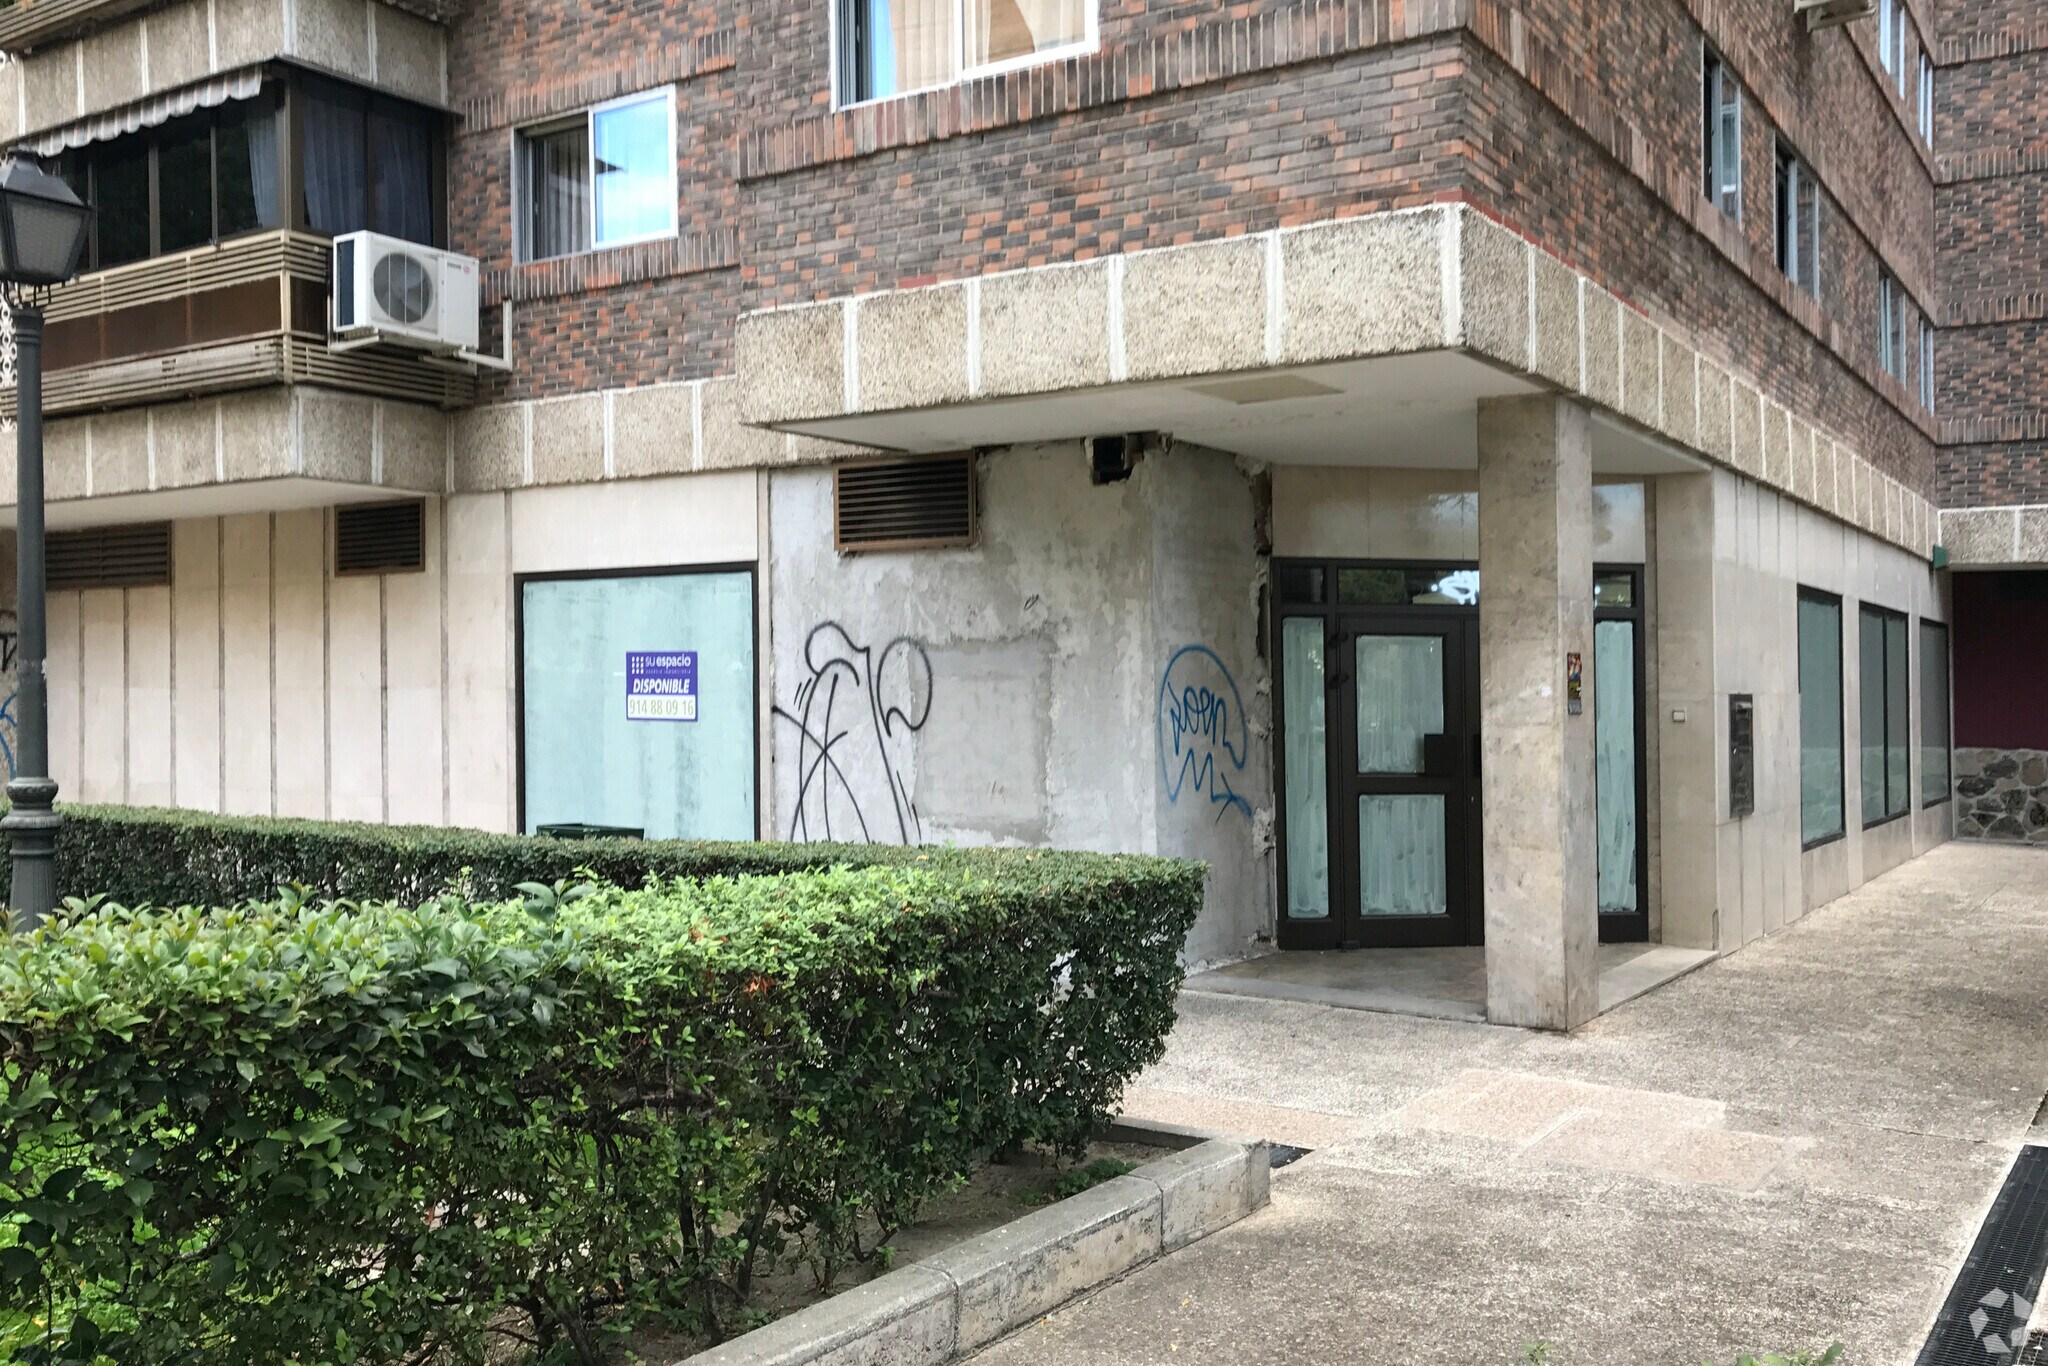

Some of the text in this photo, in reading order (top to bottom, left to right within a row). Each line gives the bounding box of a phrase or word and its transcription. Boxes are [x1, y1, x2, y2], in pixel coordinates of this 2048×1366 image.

[633, 678, 690, 694] DISPONIBLE
[629, 699, 694, 716] 914 88 09 16
